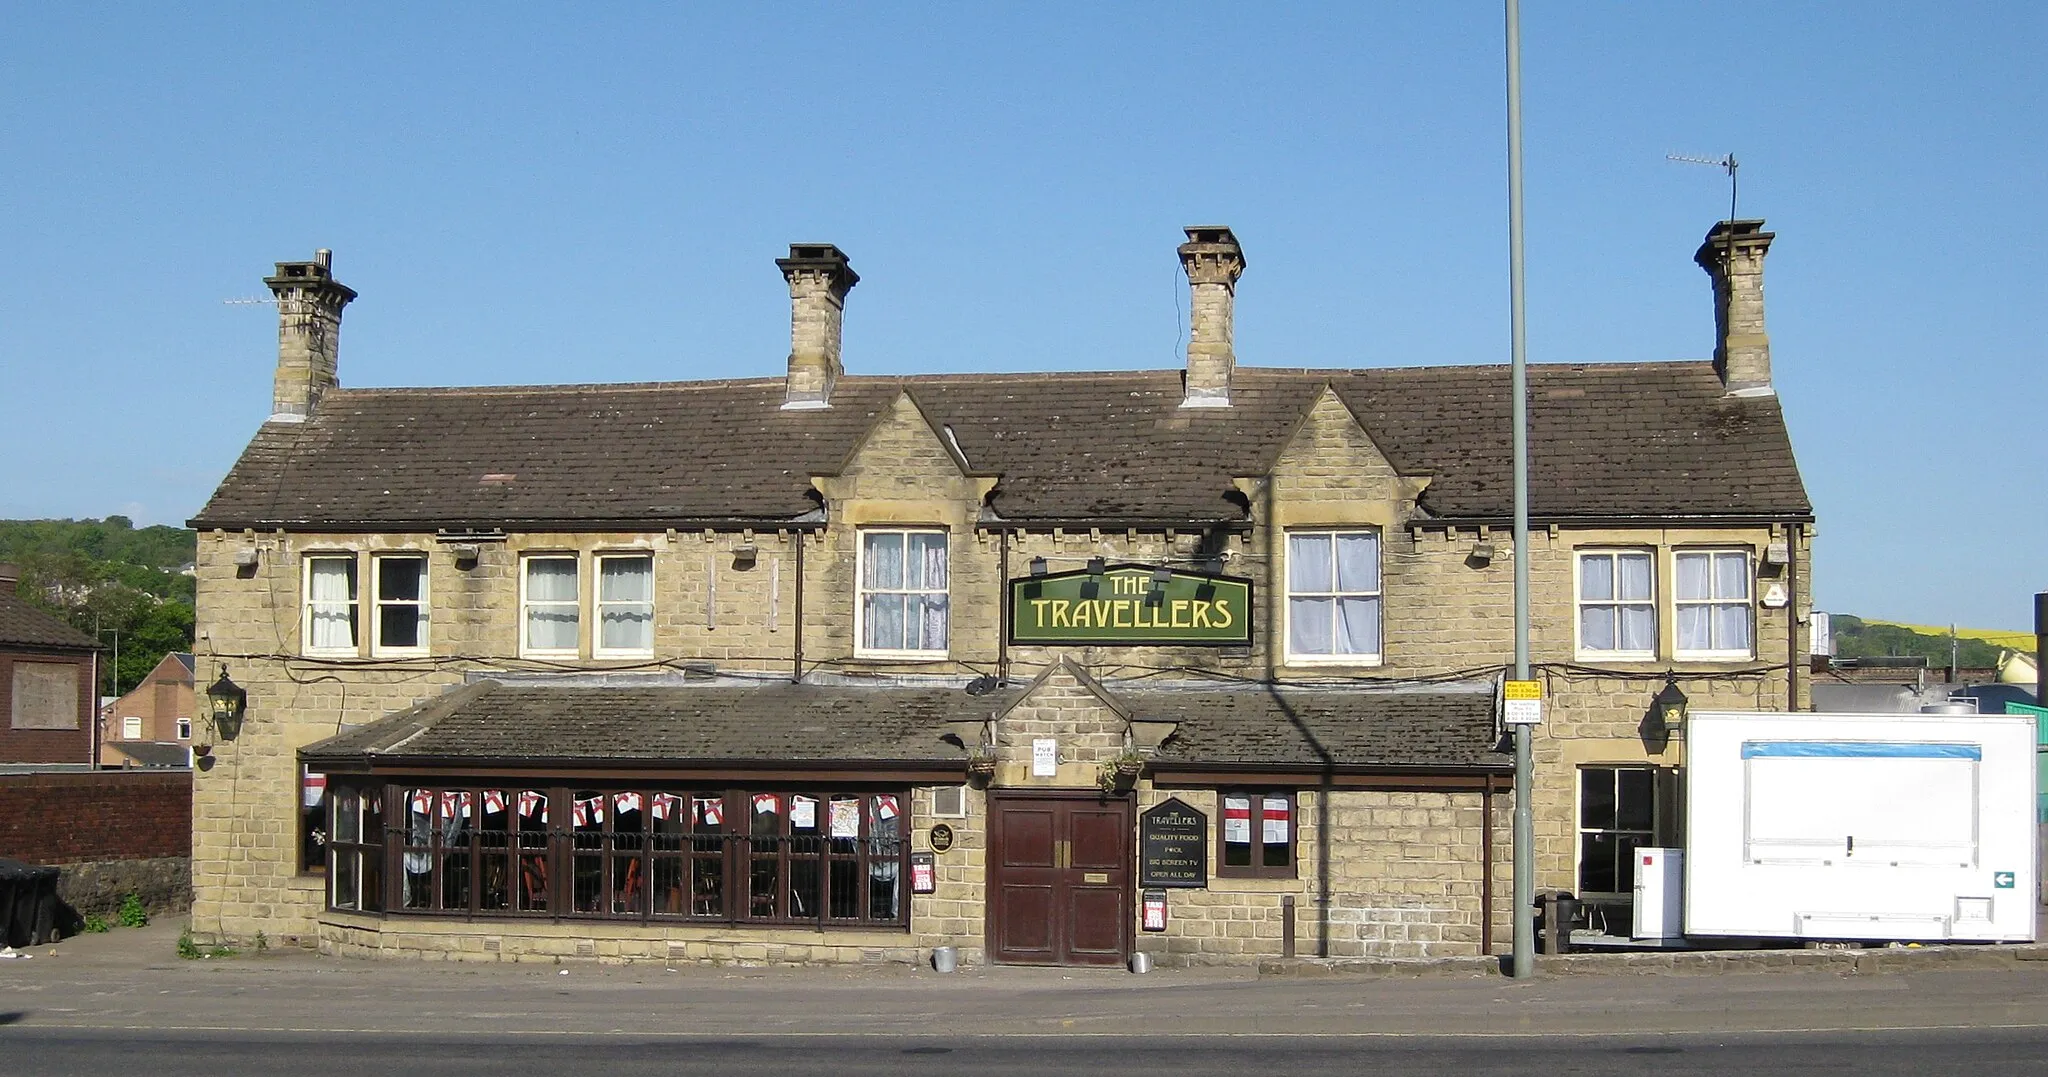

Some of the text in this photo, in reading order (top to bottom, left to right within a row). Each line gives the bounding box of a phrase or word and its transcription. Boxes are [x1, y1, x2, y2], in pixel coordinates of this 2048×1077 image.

[1110, 576, 1150, 595] THE
[1031, 599, 1233, 629] TRAVELLERS
[1152, 816, 1197, 825] TRAVELLERS
